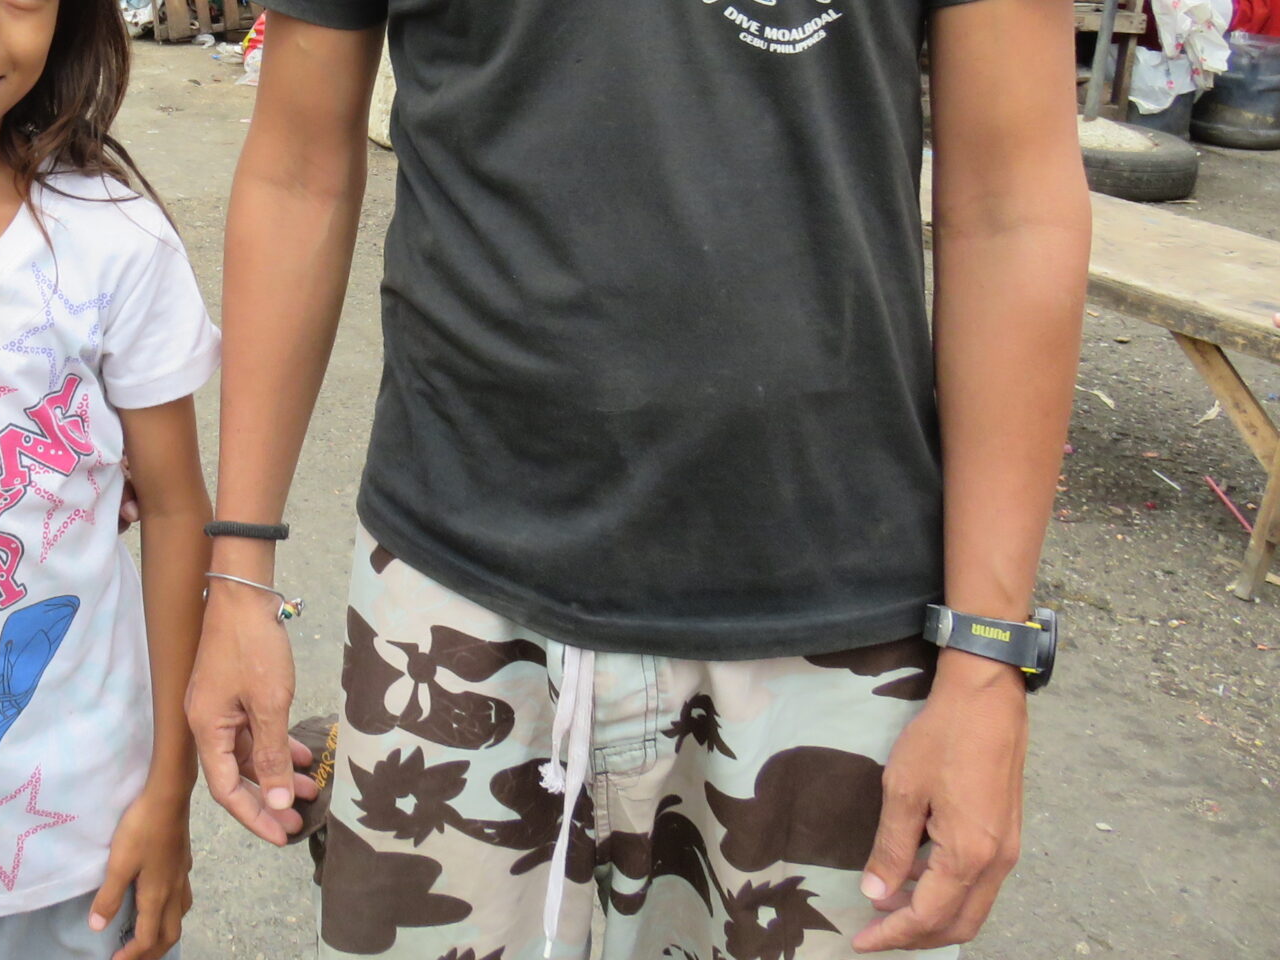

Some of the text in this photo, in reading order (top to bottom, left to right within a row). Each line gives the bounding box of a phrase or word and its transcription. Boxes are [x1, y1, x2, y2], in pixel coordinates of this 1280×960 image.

[723, 6, 843, 41] DIVE MOALBOAL
[739, 31, 768, 50] CEBU
[972, 623, 1011, 642] PUMA
